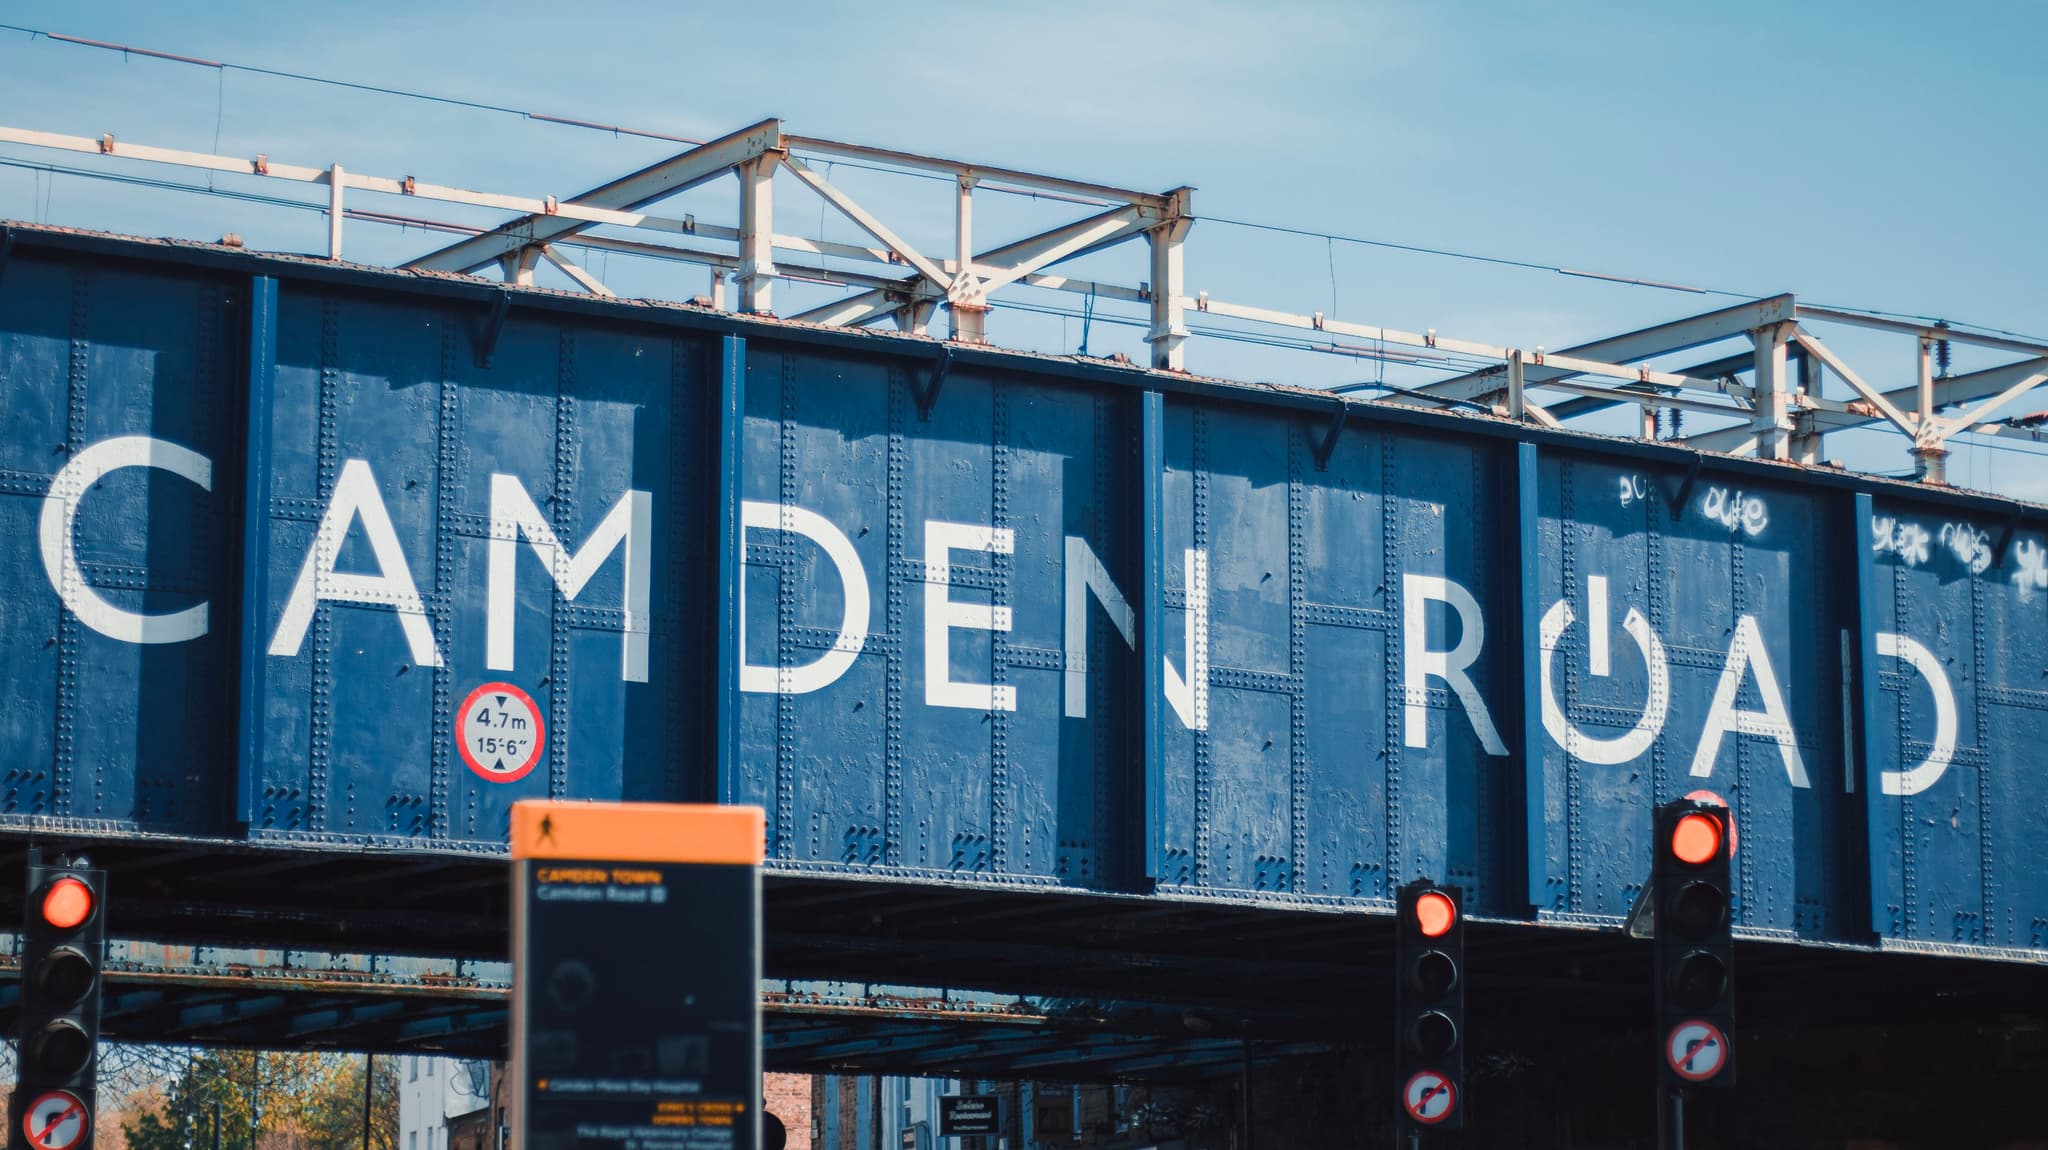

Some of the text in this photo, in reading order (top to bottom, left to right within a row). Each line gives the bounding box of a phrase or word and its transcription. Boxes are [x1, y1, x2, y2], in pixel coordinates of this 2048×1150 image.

[40, 436, 1957, 796] CAMDEN ROAD
[476, 707, 527, 730] 4.7m
[537, 869, 662, 884] CAMDEN TOWN
[537, 885, 646, 901] Camden Road
